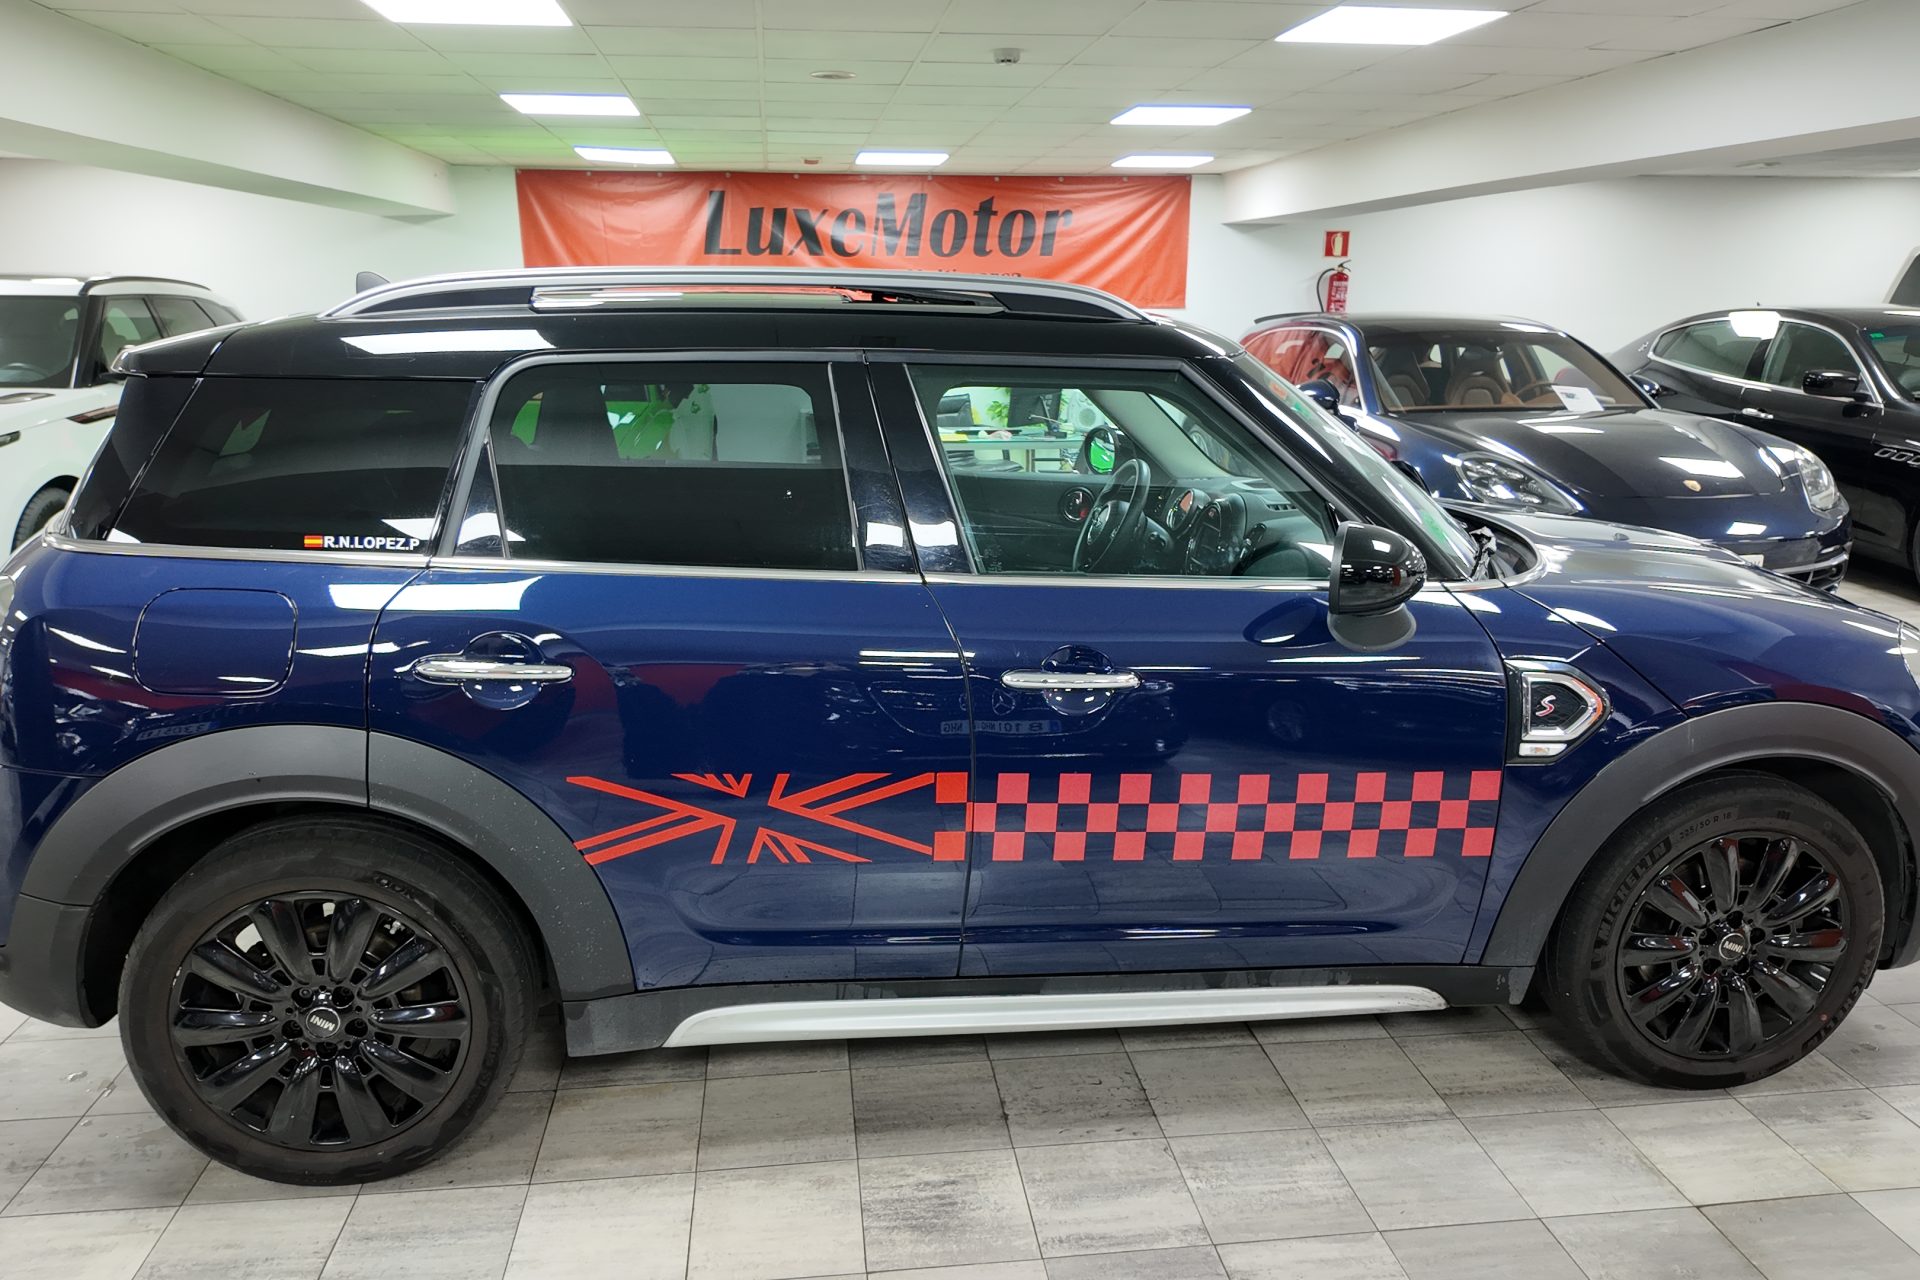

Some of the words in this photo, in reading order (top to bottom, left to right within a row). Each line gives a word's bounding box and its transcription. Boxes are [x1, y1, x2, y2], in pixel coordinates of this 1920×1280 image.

[703, 189, 1073, 257] LuxeMotor
[323, 535, 420, 551] R.N.LOPEZ.P
[1535, 694, 1557, 717] S
[1595, 838, 1671, 942] MICHELIN
[1723, 940, 1744, 953] MINI
[309, 1014, 336, 1031] MINI
